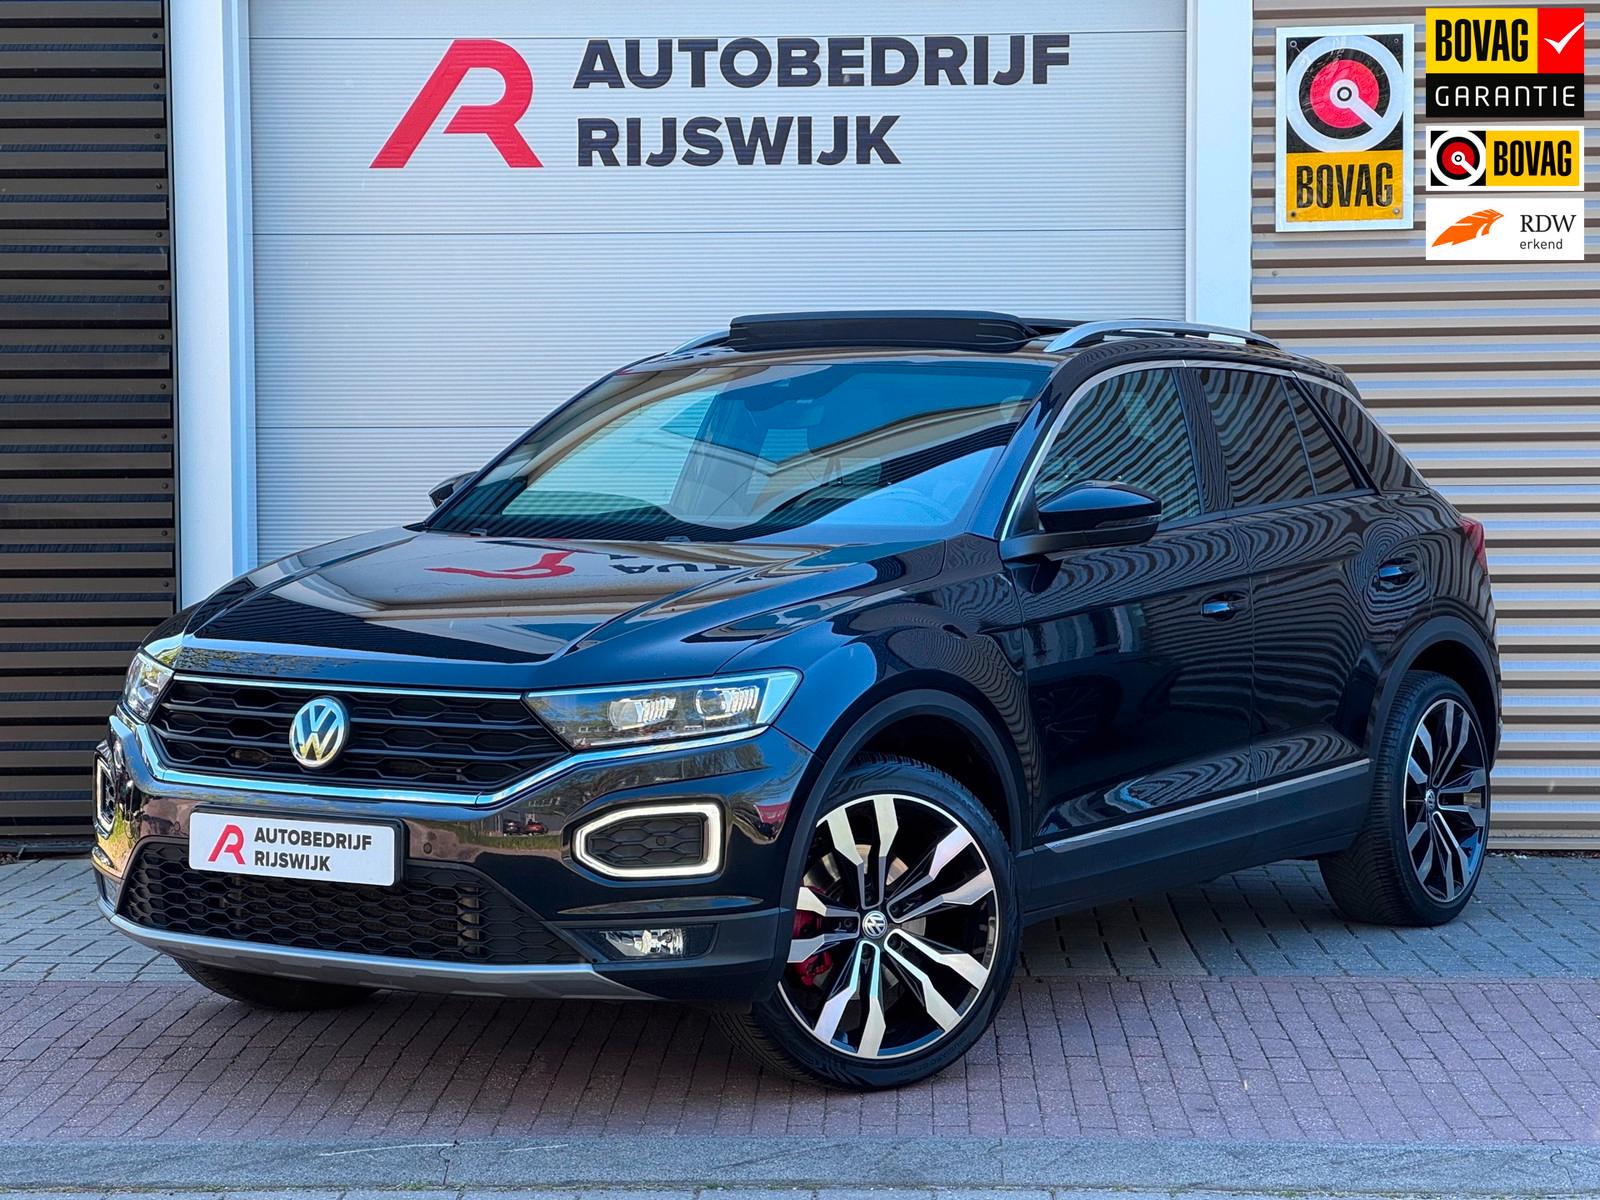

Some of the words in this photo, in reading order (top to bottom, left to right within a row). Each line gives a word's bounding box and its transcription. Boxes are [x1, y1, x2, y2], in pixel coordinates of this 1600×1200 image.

[572, 34, 1071, 89] AUTOBEDRIJF
[577, 115, 902, 168] RIJSWIJK
[1296, 162, 1394, 209] BOVAG
[254, 827, 372, 851] AUTOBEDRIJF
[254, 850, 331, 872] RIJSWIJK
